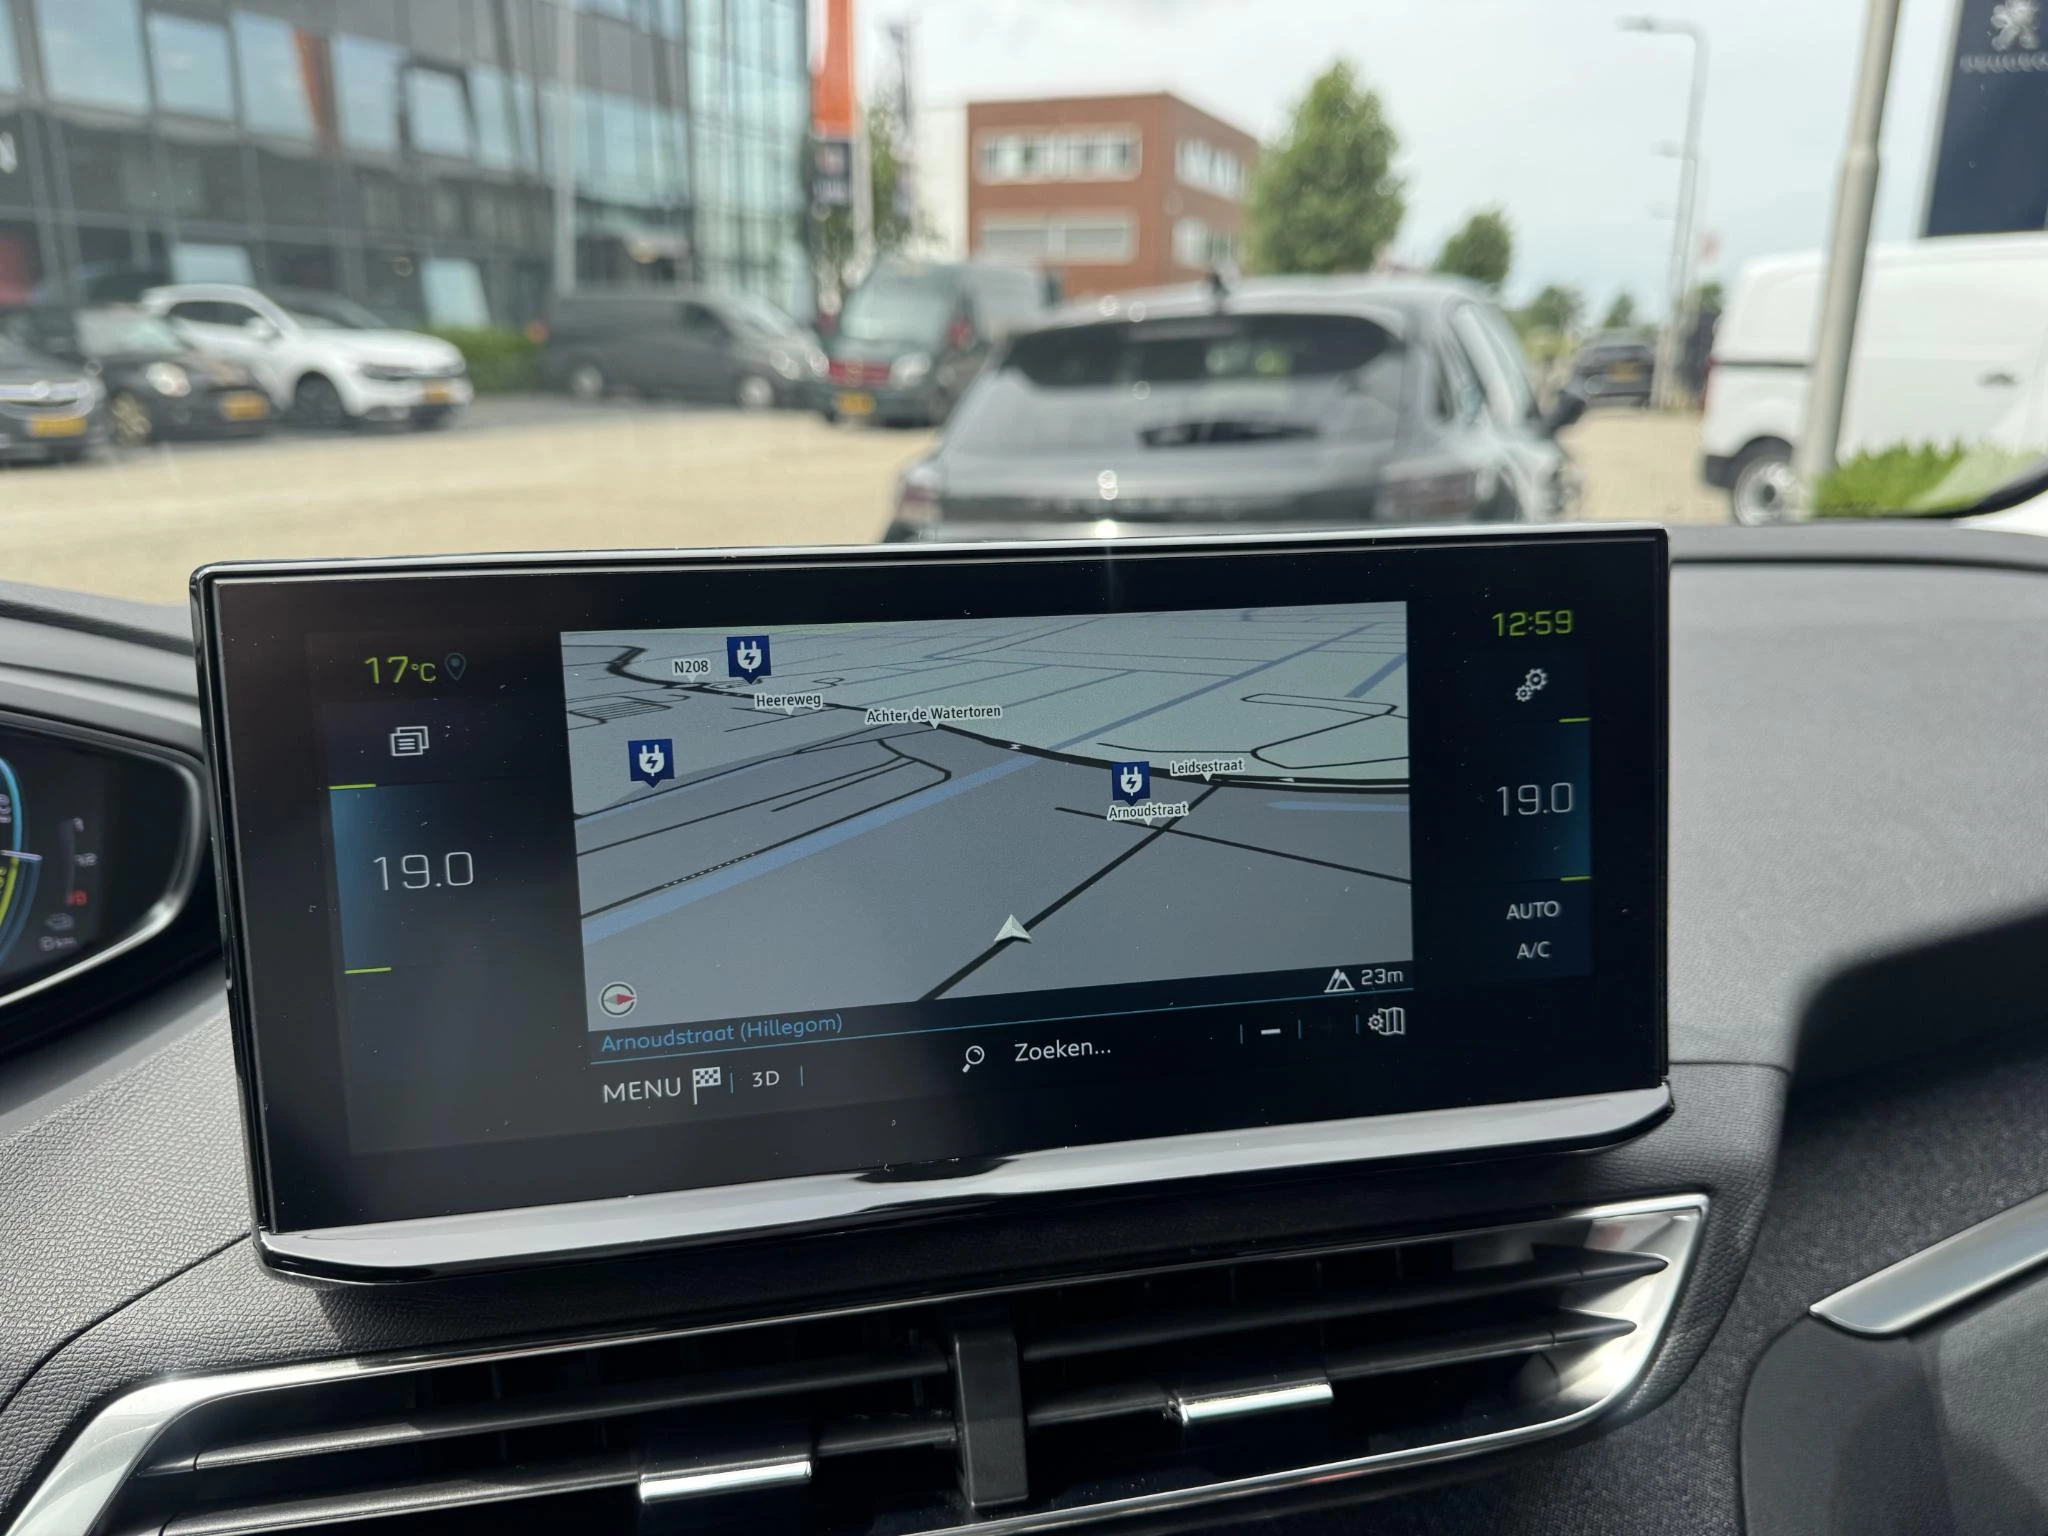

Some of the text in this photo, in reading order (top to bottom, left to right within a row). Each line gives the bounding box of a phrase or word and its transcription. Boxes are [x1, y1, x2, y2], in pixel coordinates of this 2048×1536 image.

[1492, 609, 1574, 637] 12:59
[364, 655, 437, 684] 17°C
[673, 659, 709, 674] N208
[756, 693, 822, 709] Heereweg
[866, 705, 1001, 723] Achter de Watertoren
[1172, 760, 1243, 775] Leidsestraat
[1496, 782, 1574, 816] 19.0
[1109, 804, 1187, 819] Arnoudstraat
[373, 851, 474, 891] 19.0
[1506, 901, 1560, 920] AUTO
[1516, 941, 1553, 960] A/C
[1361, 968, 1404, 985] 23m
[601, 1013, 843, 1052] Arnoudstraat (Hillegom)
[751, 1070, 780, 1088] 3D
[603, 1076, 682, 1103] MENU
